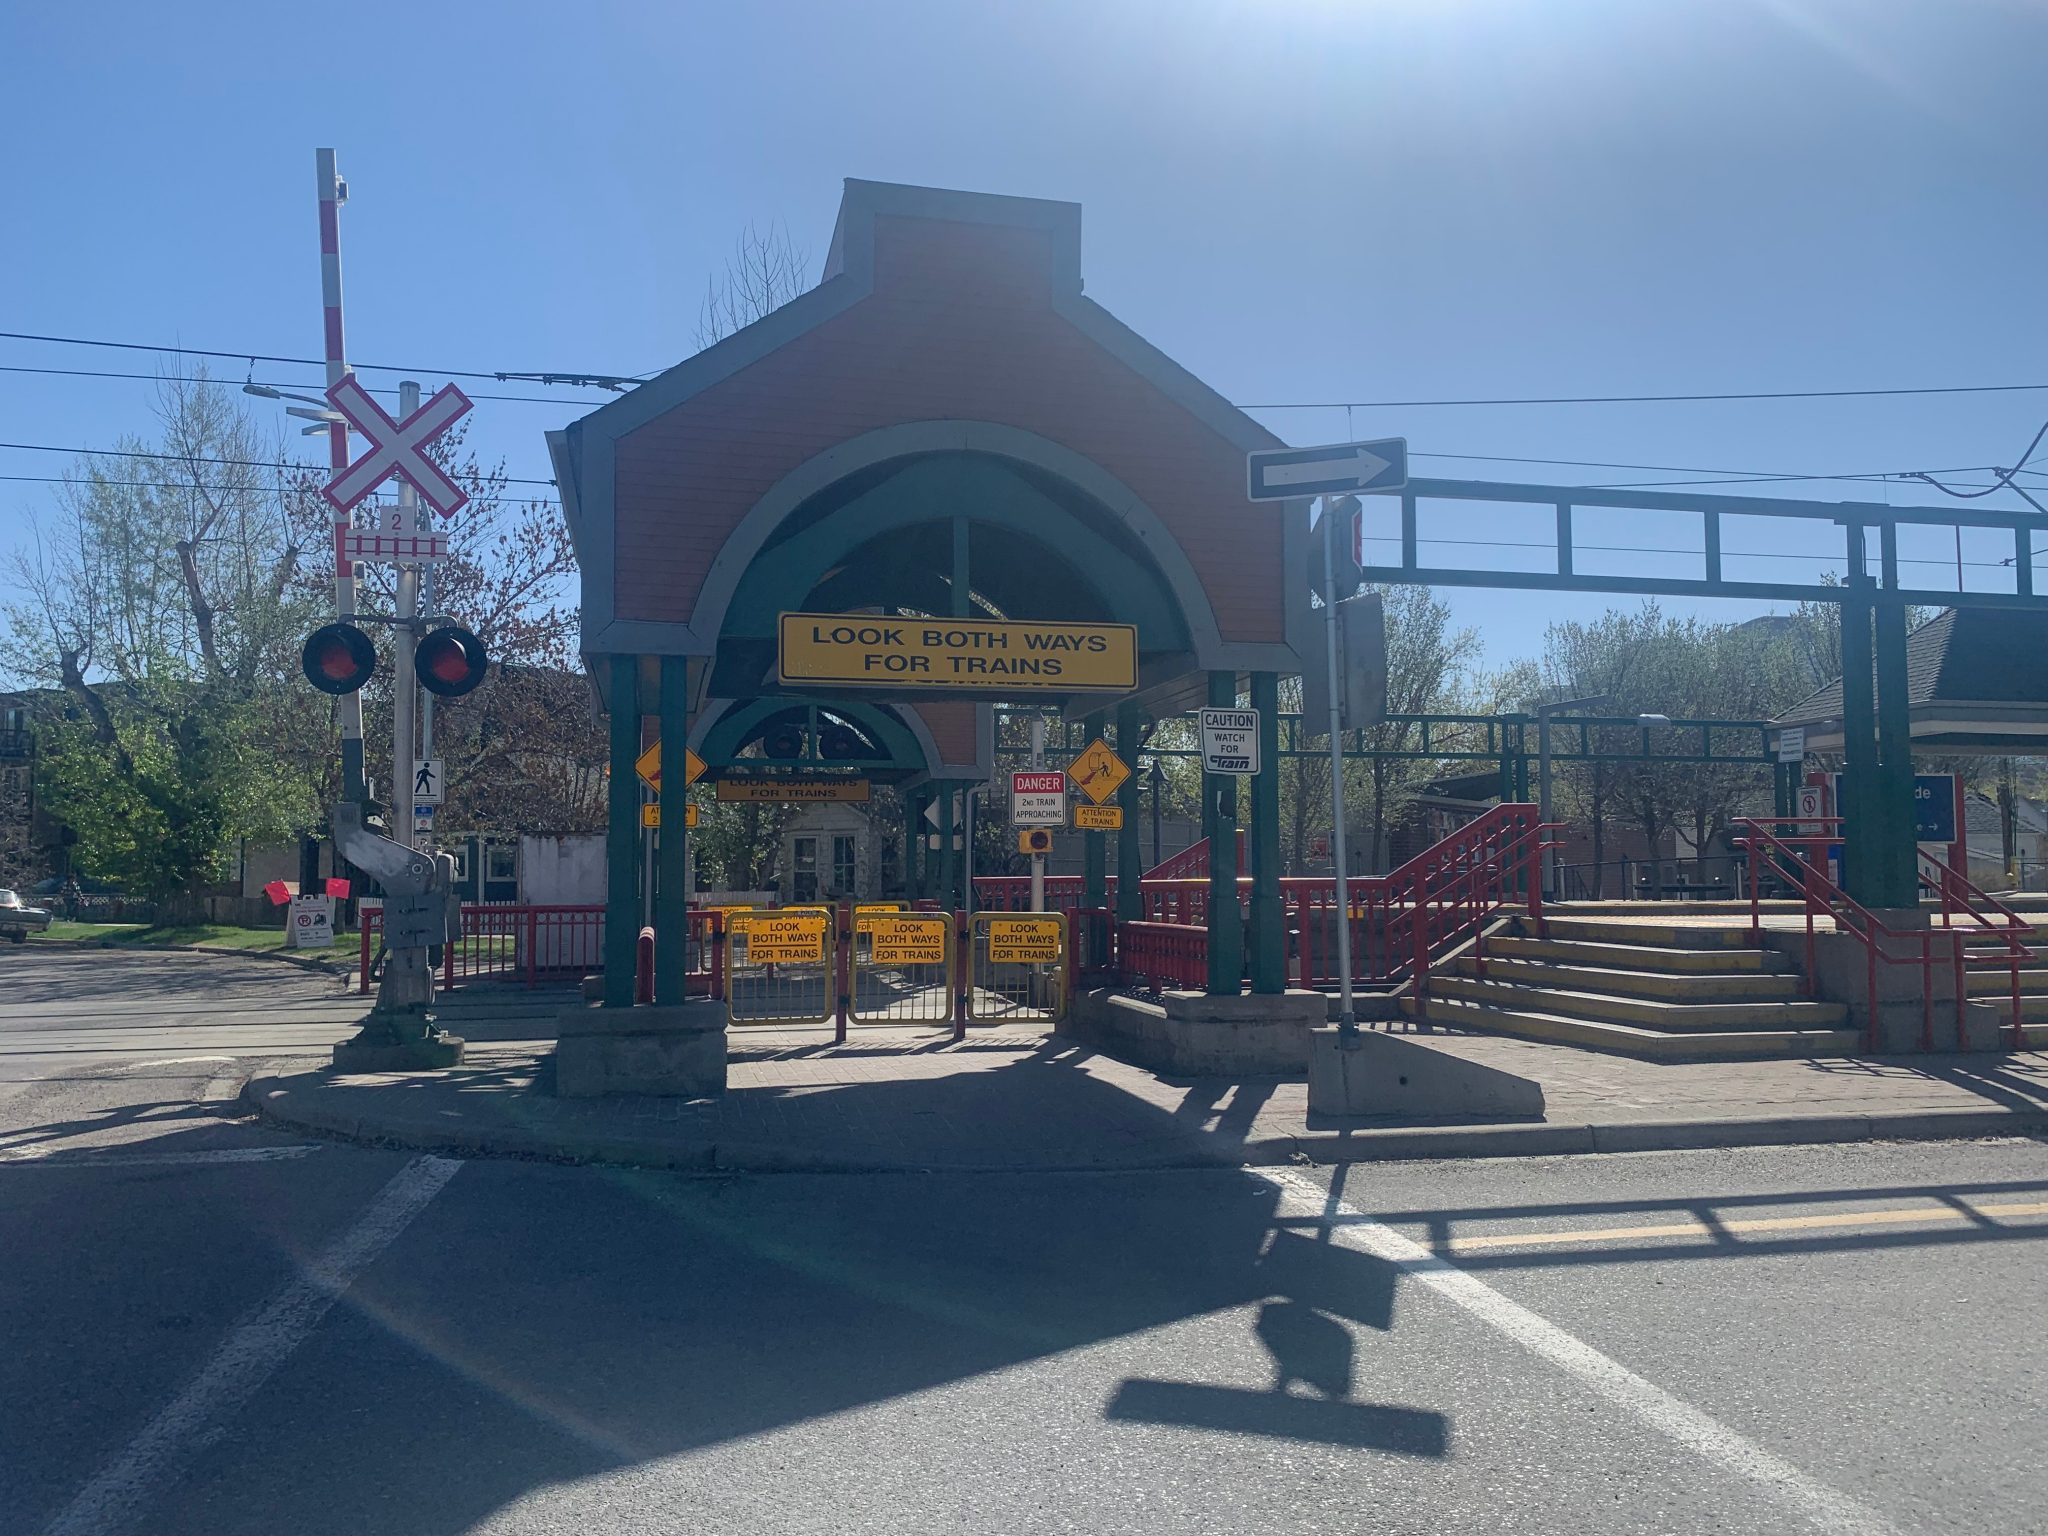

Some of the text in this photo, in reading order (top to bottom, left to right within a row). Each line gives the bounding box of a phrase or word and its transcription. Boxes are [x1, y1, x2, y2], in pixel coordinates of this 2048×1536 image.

[392, 513, 402, 530] 2
[812, 626, 1107, 652] LOOK BOTH WAYS
[864, 654, 1062, 675] FOR TRAINS
[1205, 713, 1254, 727] CAUTION
[1214, 733, 1245, 742] WATCH
[1220, 744, 1239, 753] FOR
[1017, 777, 1060, 790] DANGER
[750, 789, 837, 798] FOR TRAINS
[1036, 798, 1056, 806] TRAIN
[1015, 810, 1062, 819] APPROACHING
[1081, 808, 1117, 817] ATTENTION
[1083, 817, 1114, 825] 2 TRAINS
[769, 922, 800, 932] LOOK
[894, 924, 924, 933] LOOK
[1010, 924, 1039, 933] LOOK
[752, 933, 818, 943] BOTH WAYS
[877, 934, 940, 944] BOTH WAYS
[994, 934, 1055, 944] BOTH WAYS
[751, 949, 818, 959] FOR TRAINS
[876, 950, 941, 960] FOR TRAINS
[992, 950, 1056, 960] FOR TRAINS
